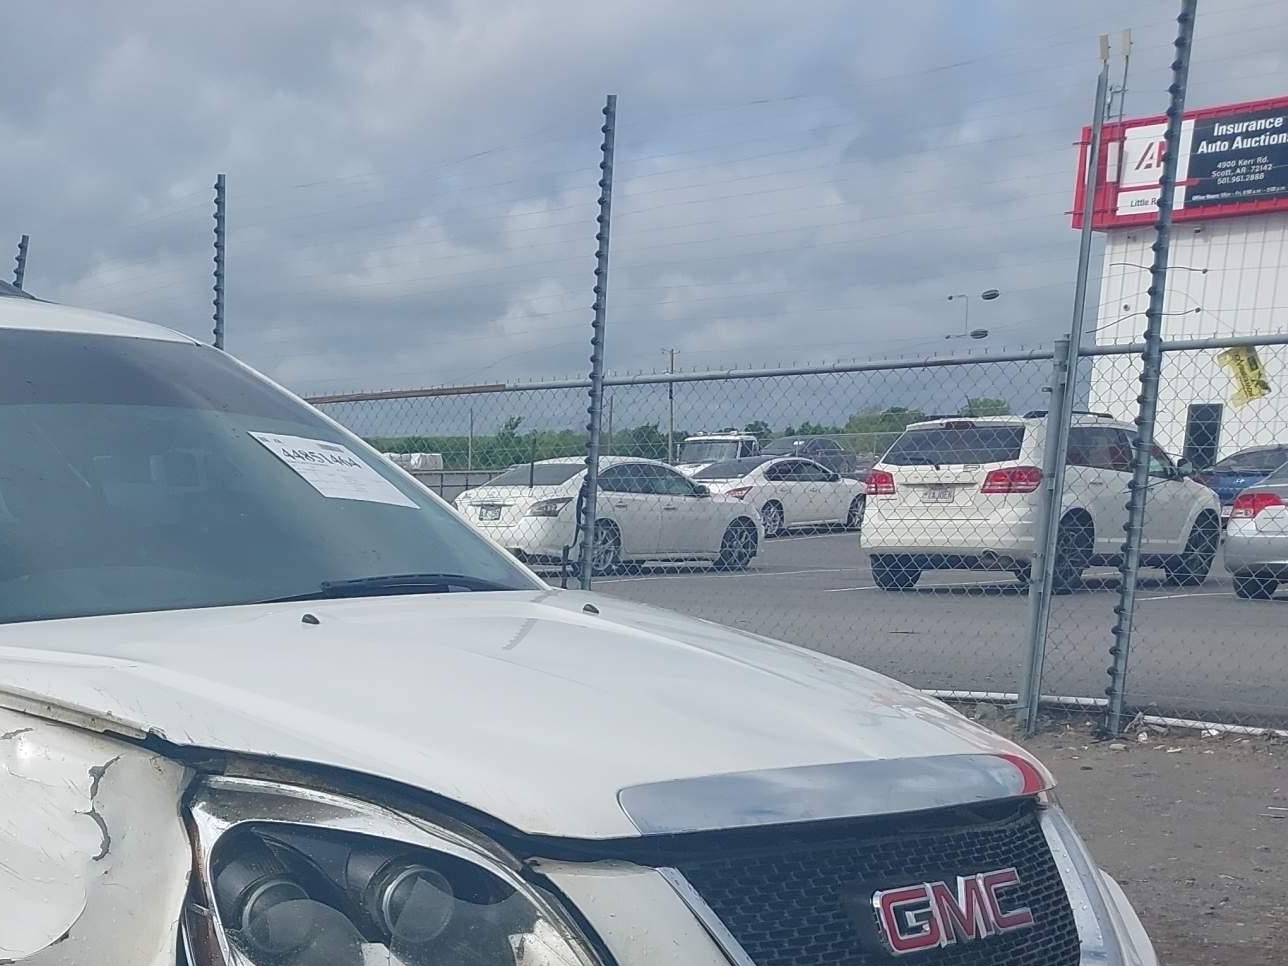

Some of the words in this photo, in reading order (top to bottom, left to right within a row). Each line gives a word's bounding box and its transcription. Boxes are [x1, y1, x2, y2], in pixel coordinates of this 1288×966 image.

[1214, 116, 1283, 136] Insurance
[1197, 140, 1229, 154] Auto
[1232, 132, 1288, 150] Auction
[281, 447, 362, 469] 44851464
[872, 866, 1034, 954] GMC
